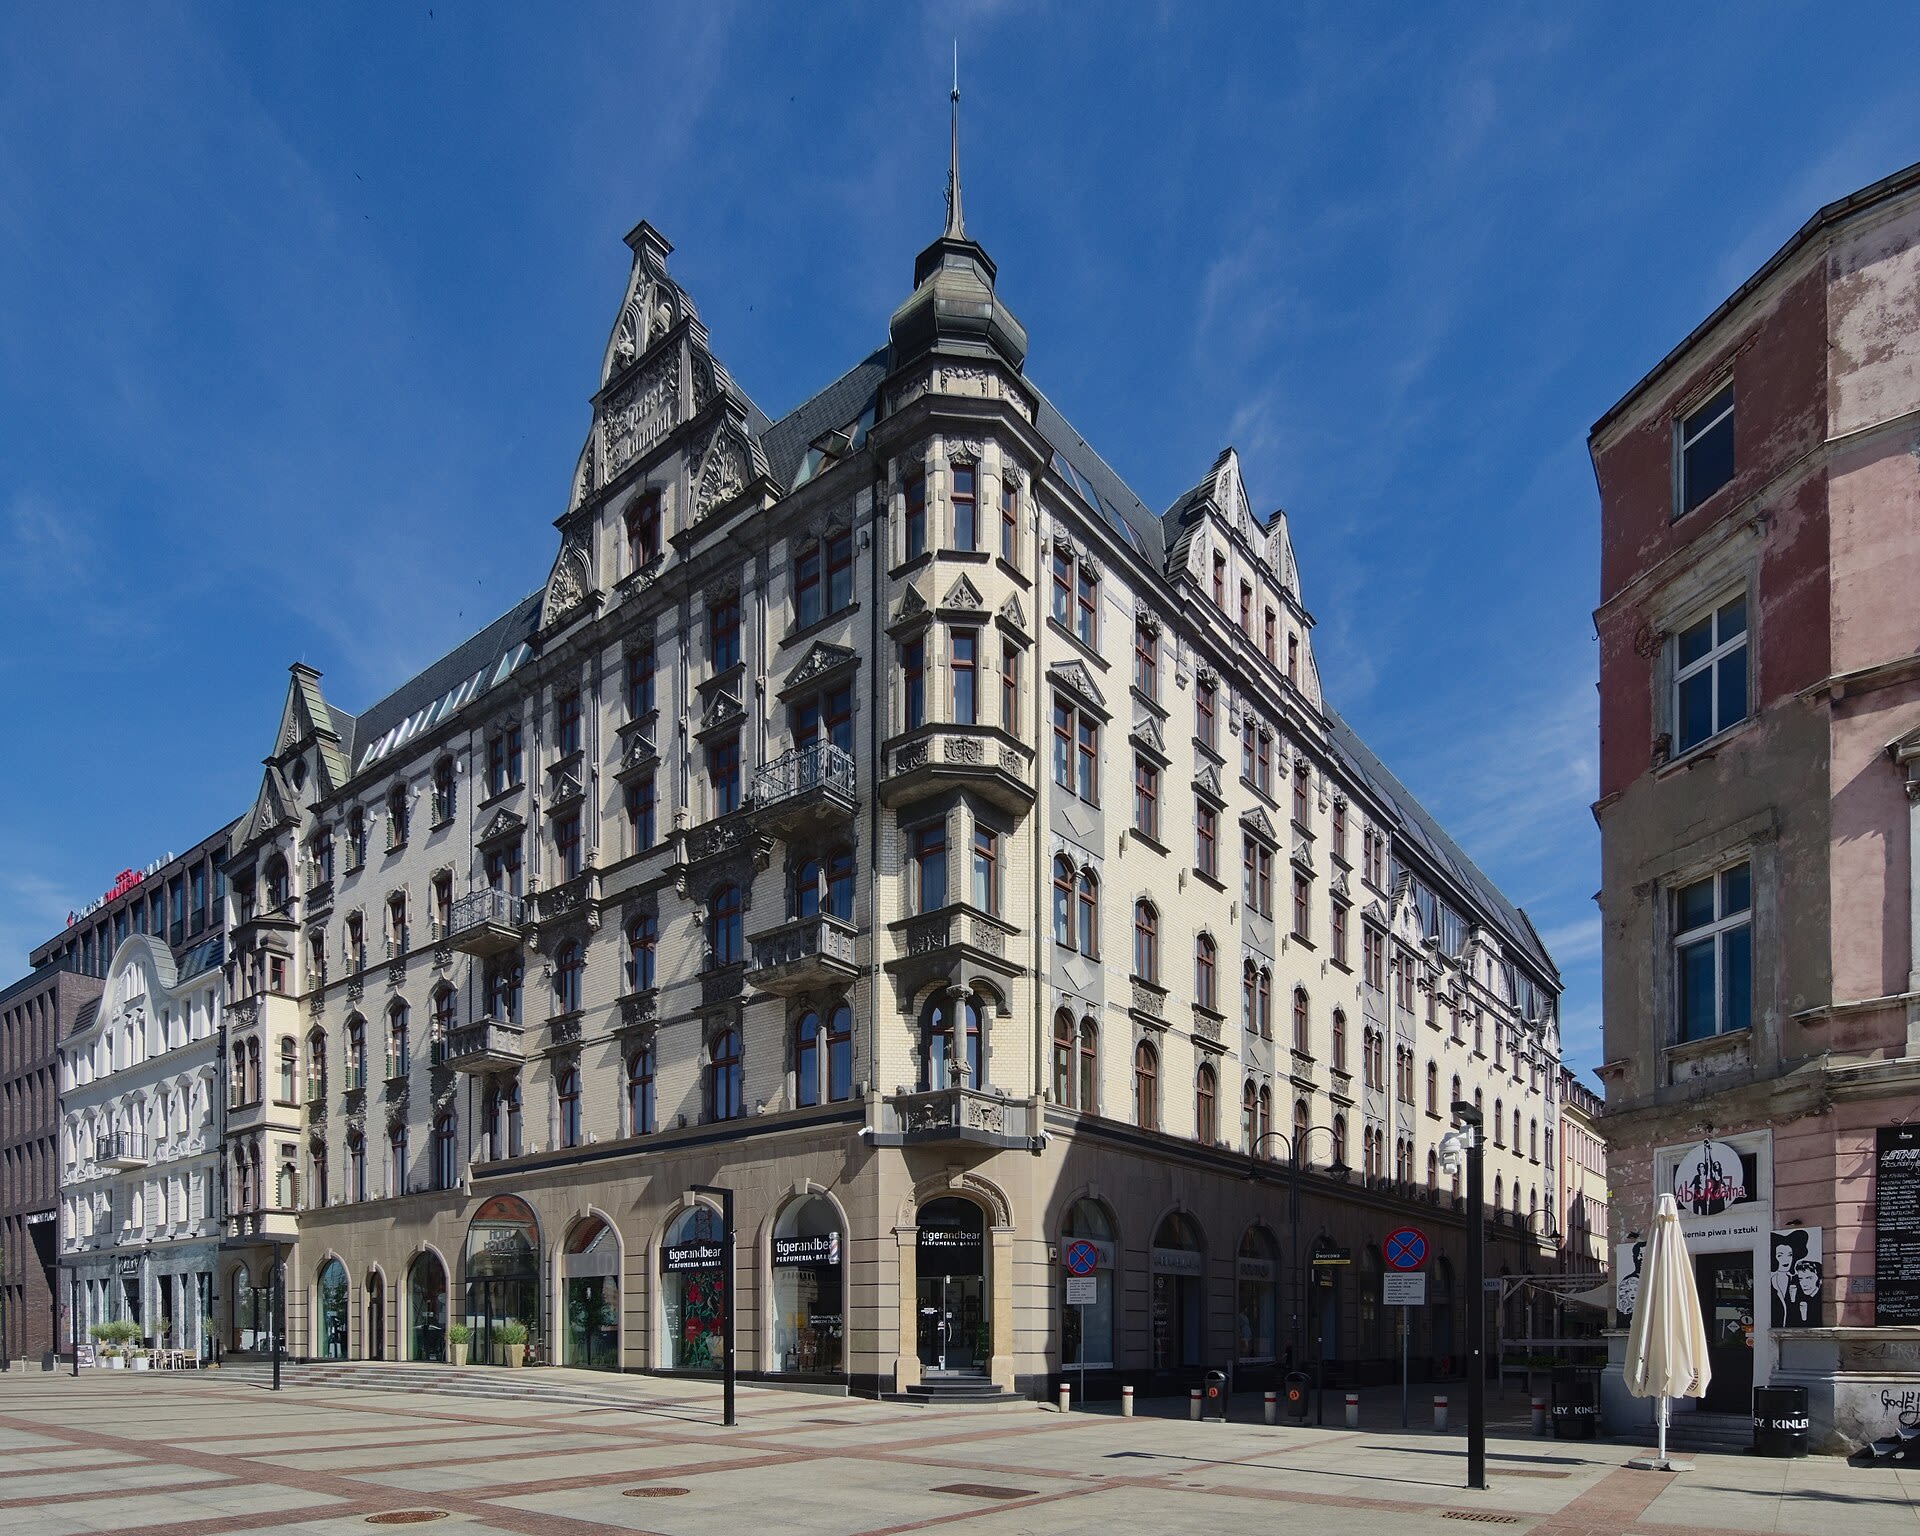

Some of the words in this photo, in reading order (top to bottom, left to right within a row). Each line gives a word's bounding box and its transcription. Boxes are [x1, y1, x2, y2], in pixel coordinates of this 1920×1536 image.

[922, 1231, 980, 1241] tigerandbear
[1682, 1231, 1705, 1240] iernia
[1708, 1229, 1726, 1238] piwa
[1734, 1226, 1758, 1234] sztuki
[669, 1246, 721, 1262] tigerandbear
[776, 1238, 831, 1255] tigerandbe
